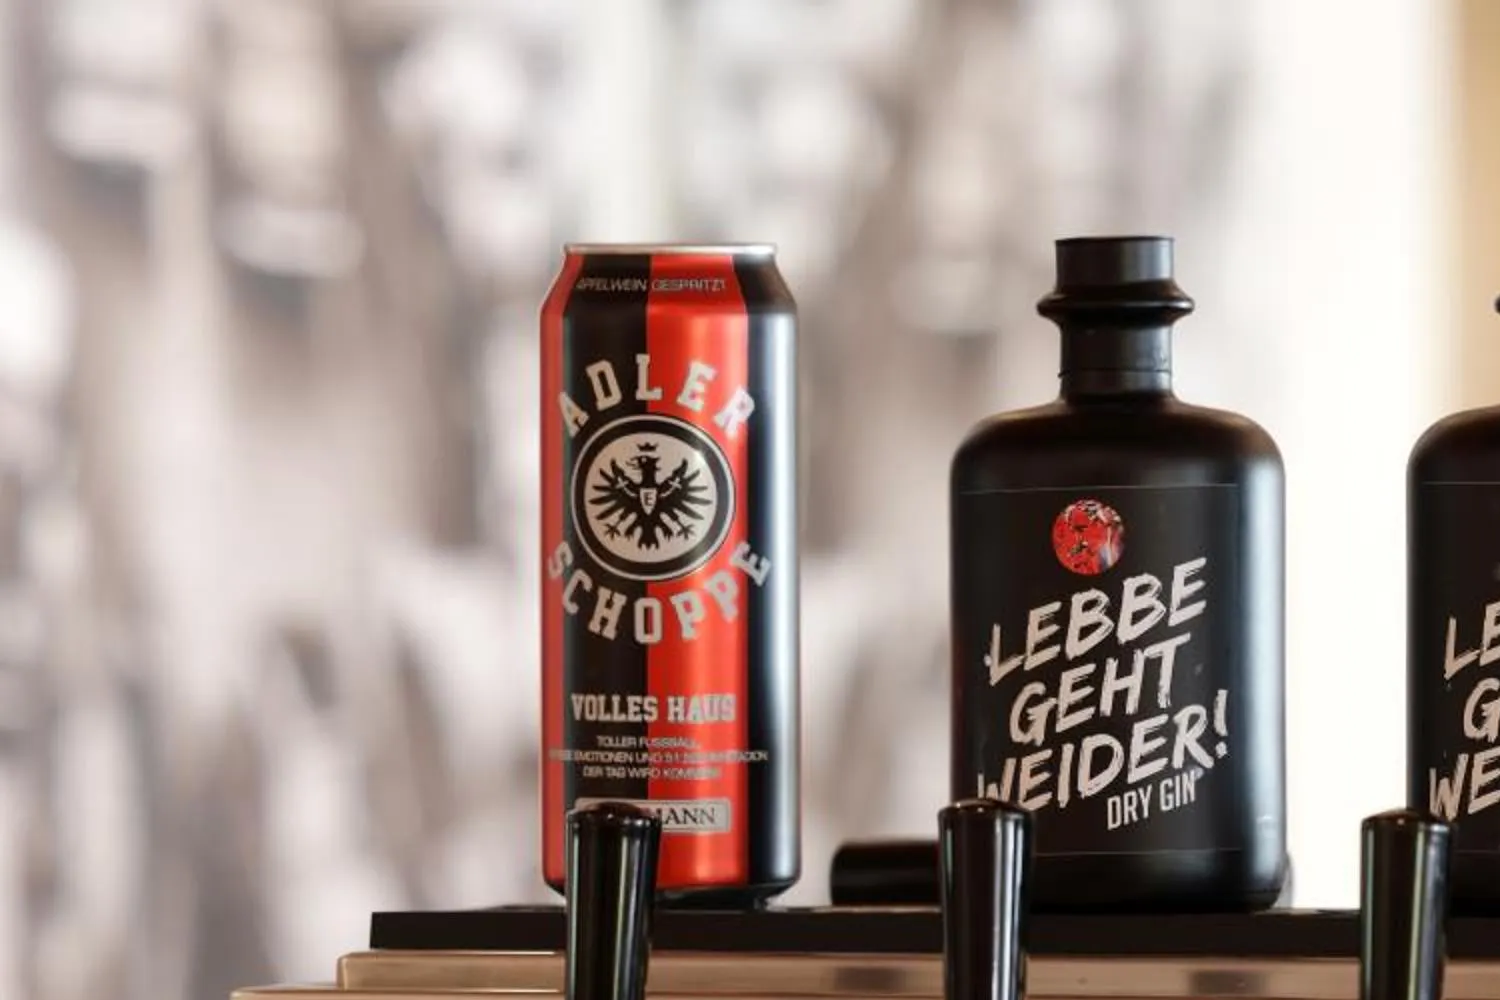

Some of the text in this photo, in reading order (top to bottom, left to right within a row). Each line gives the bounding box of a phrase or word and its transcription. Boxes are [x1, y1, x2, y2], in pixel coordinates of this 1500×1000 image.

[558, 353, 755, 439] ADLER
[548, 541, 771, 644] SCHOPPE
[988, 557, 1207, 686] LEBBE
[571, 694, 736, 724] VOLLES HAUS
[1009, 632, 1191, 746] GEHT
[596, 735, 637, 748] TOLLER
[1107, 773, 1197, 830] DRY GIN
